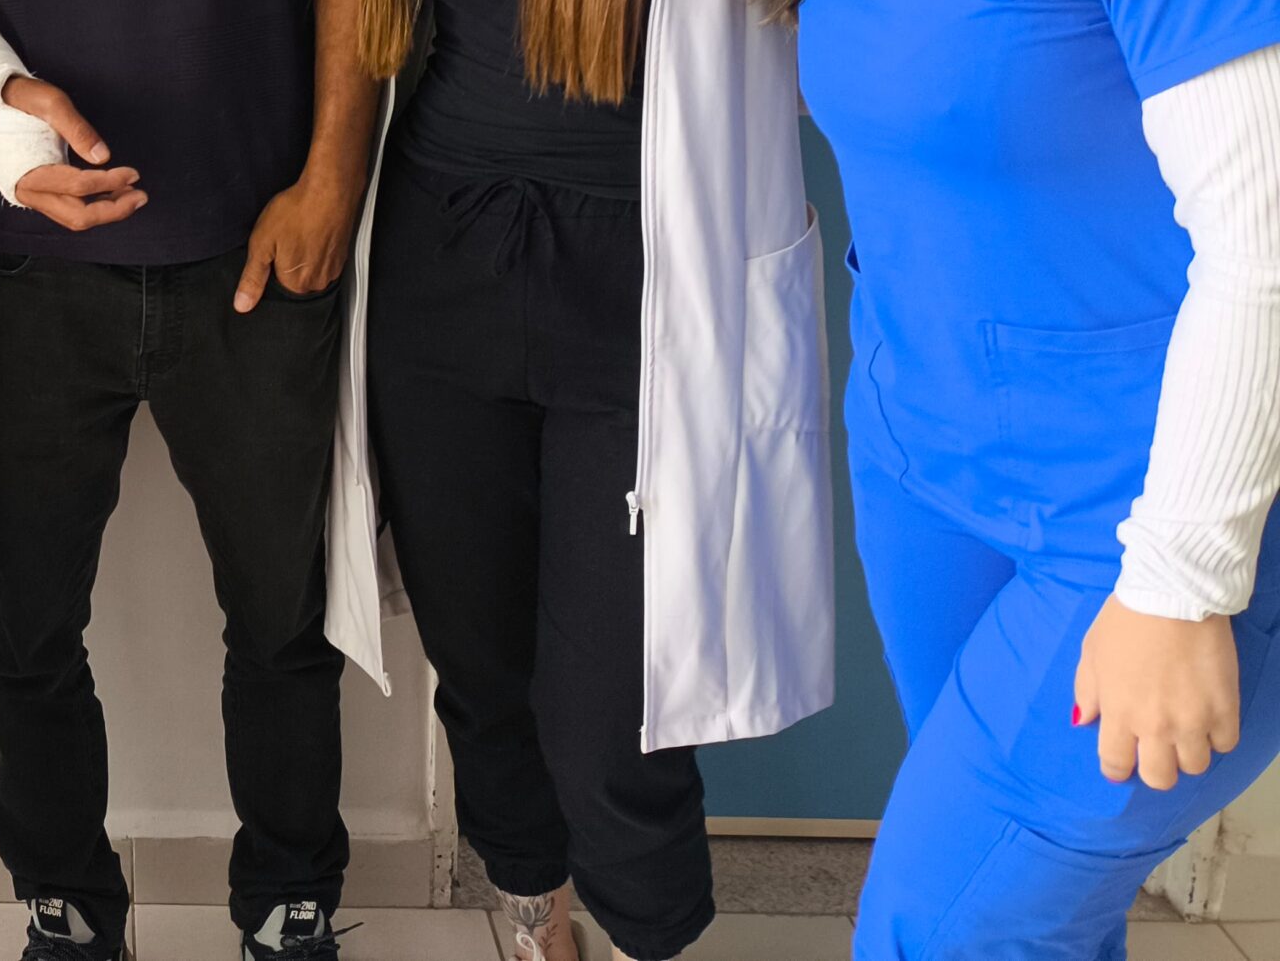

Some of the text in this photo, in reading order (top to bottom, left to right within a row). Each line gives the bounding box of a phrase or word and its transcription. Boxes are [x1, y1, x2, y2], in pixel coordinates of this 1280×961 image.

[48, 898, 64, 909] 2ND
[301, 901, 317, 911] 2ND
[39, 904, 62, 918] FLOOR
[289, 910, 316, 920] FLOOR
